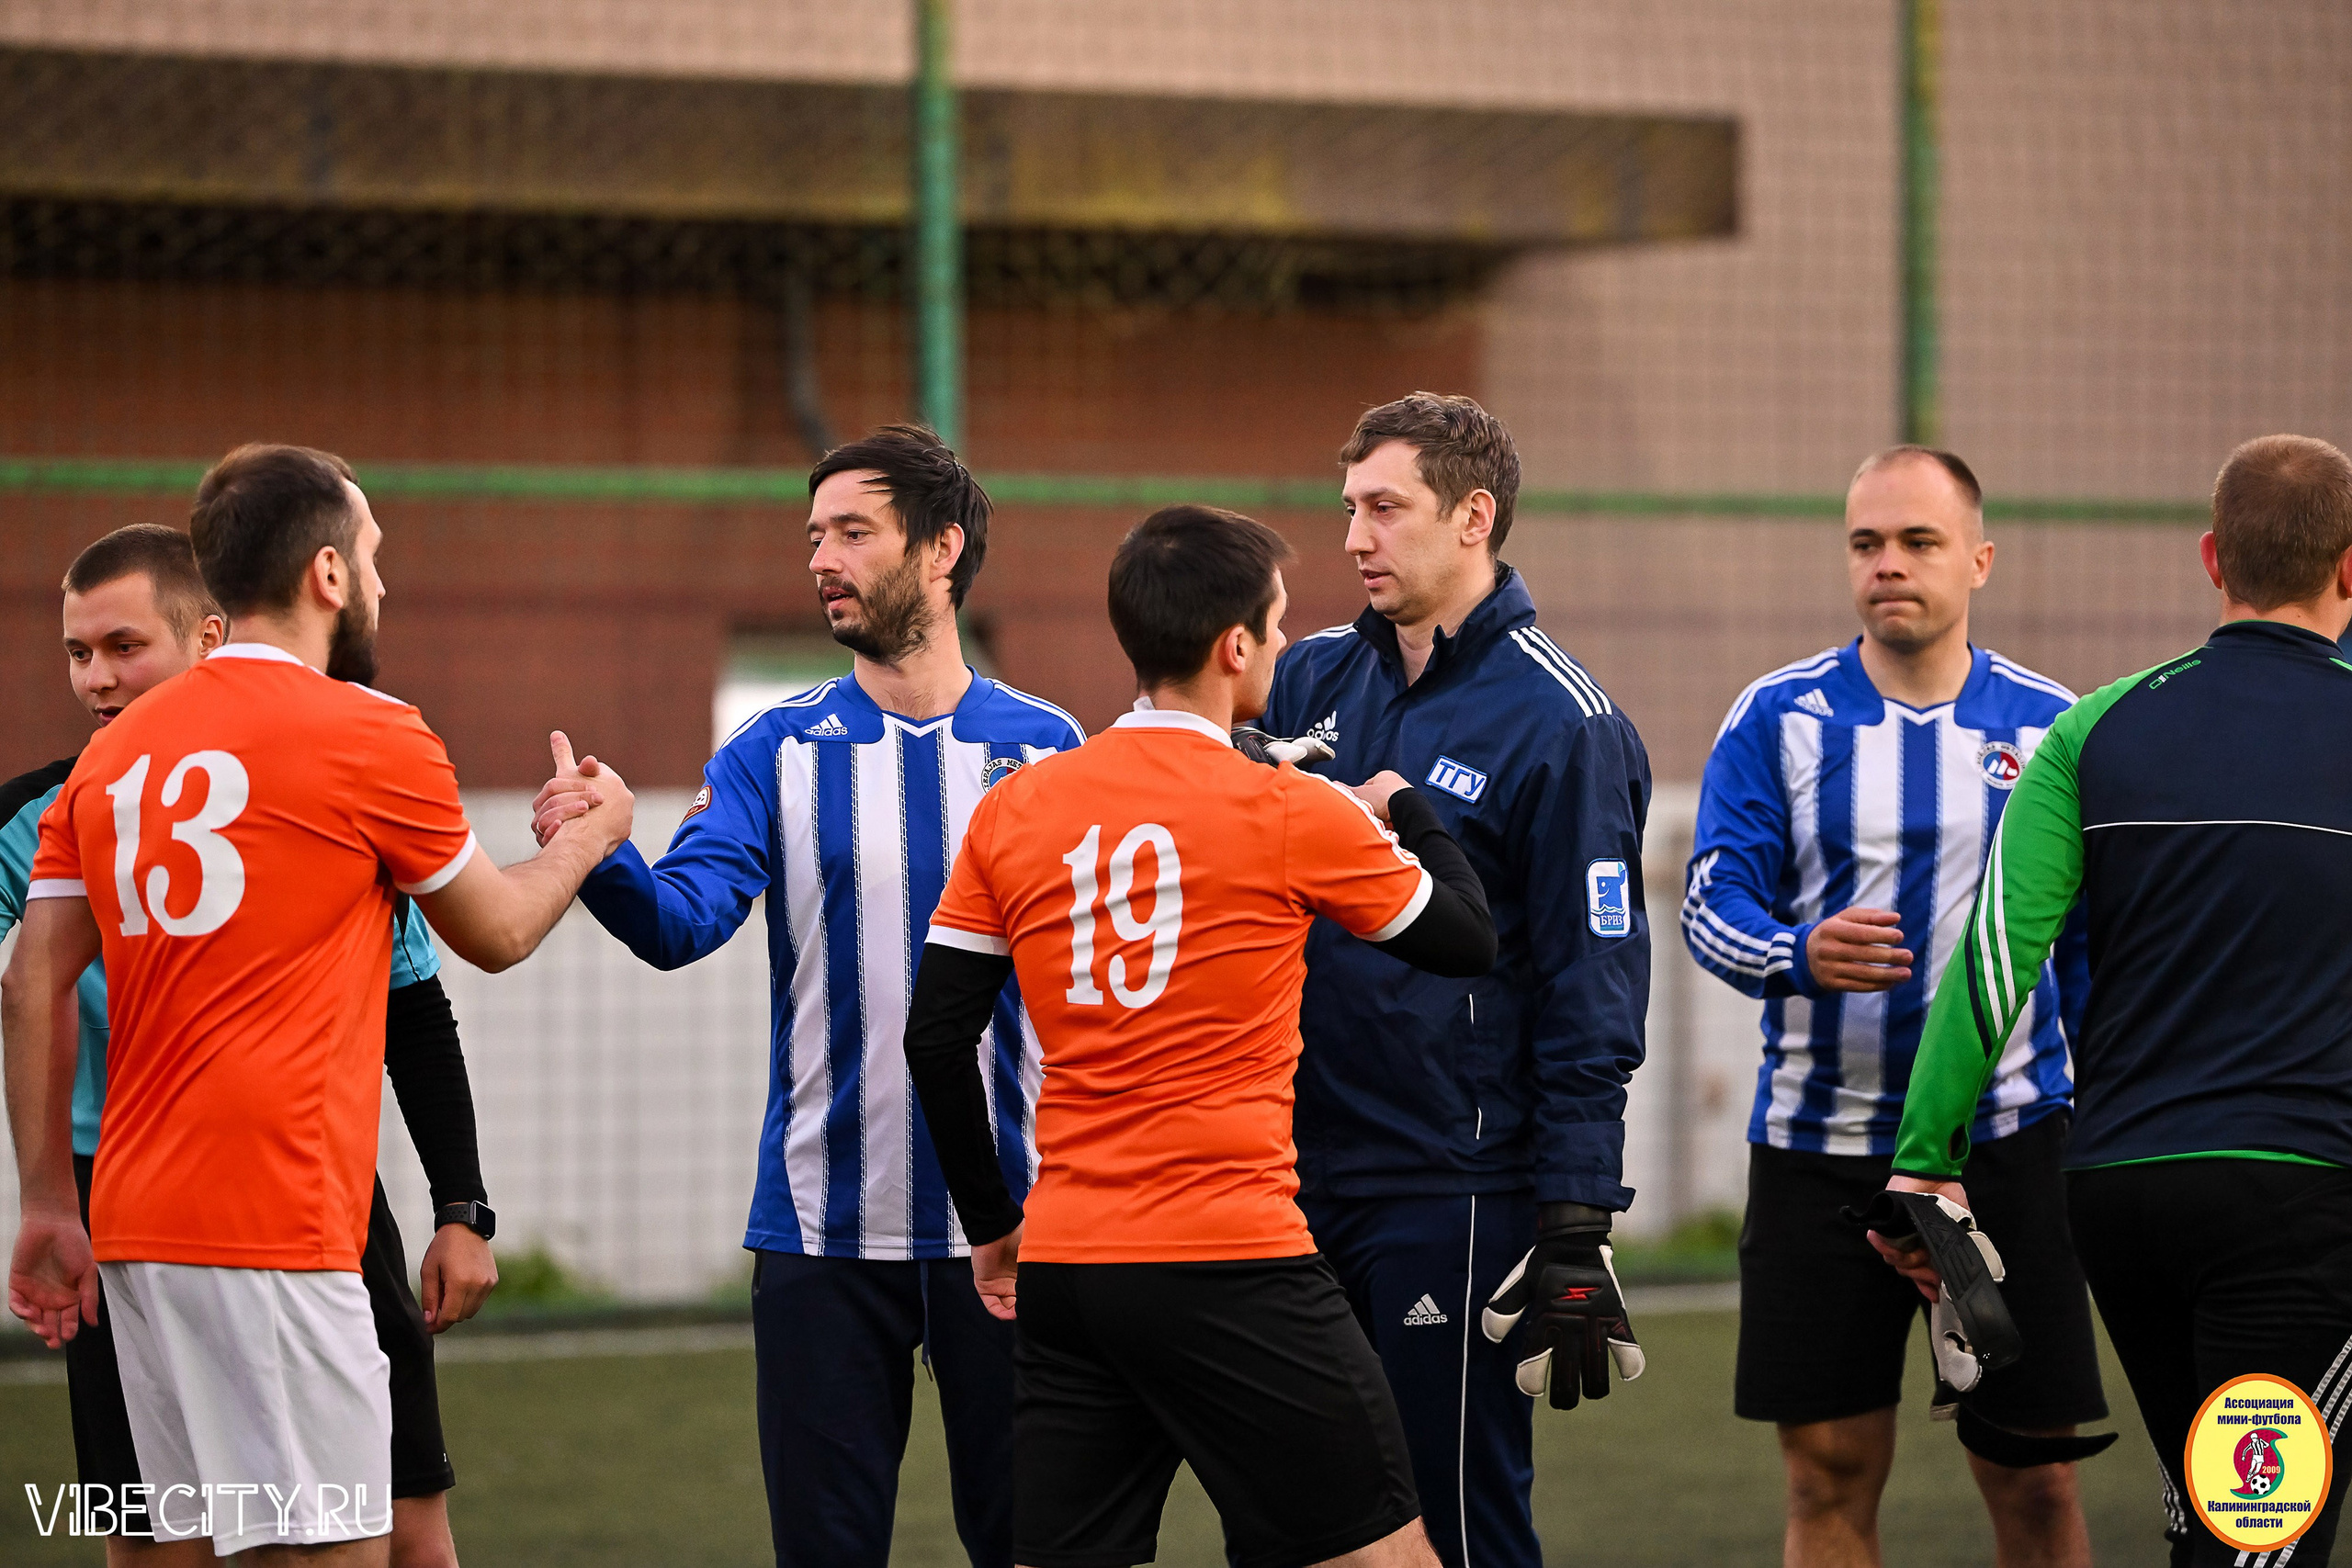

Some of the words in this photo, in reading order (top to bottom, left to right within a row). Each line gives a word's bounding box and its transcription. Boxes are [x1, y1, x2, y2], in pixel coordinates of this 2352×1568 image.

[804, 727, 848, 736] adidas
[1306, 728, 1340, 741] adas
[1435, 761, 1485, 796] ТГУ
[106, 750, 249, 937] 13
[1062, 823, 1183, 1009] 19
[1600, 915, 1623, 926] БРИЗ
[1403, 1314, 1448, 1325] adidas
